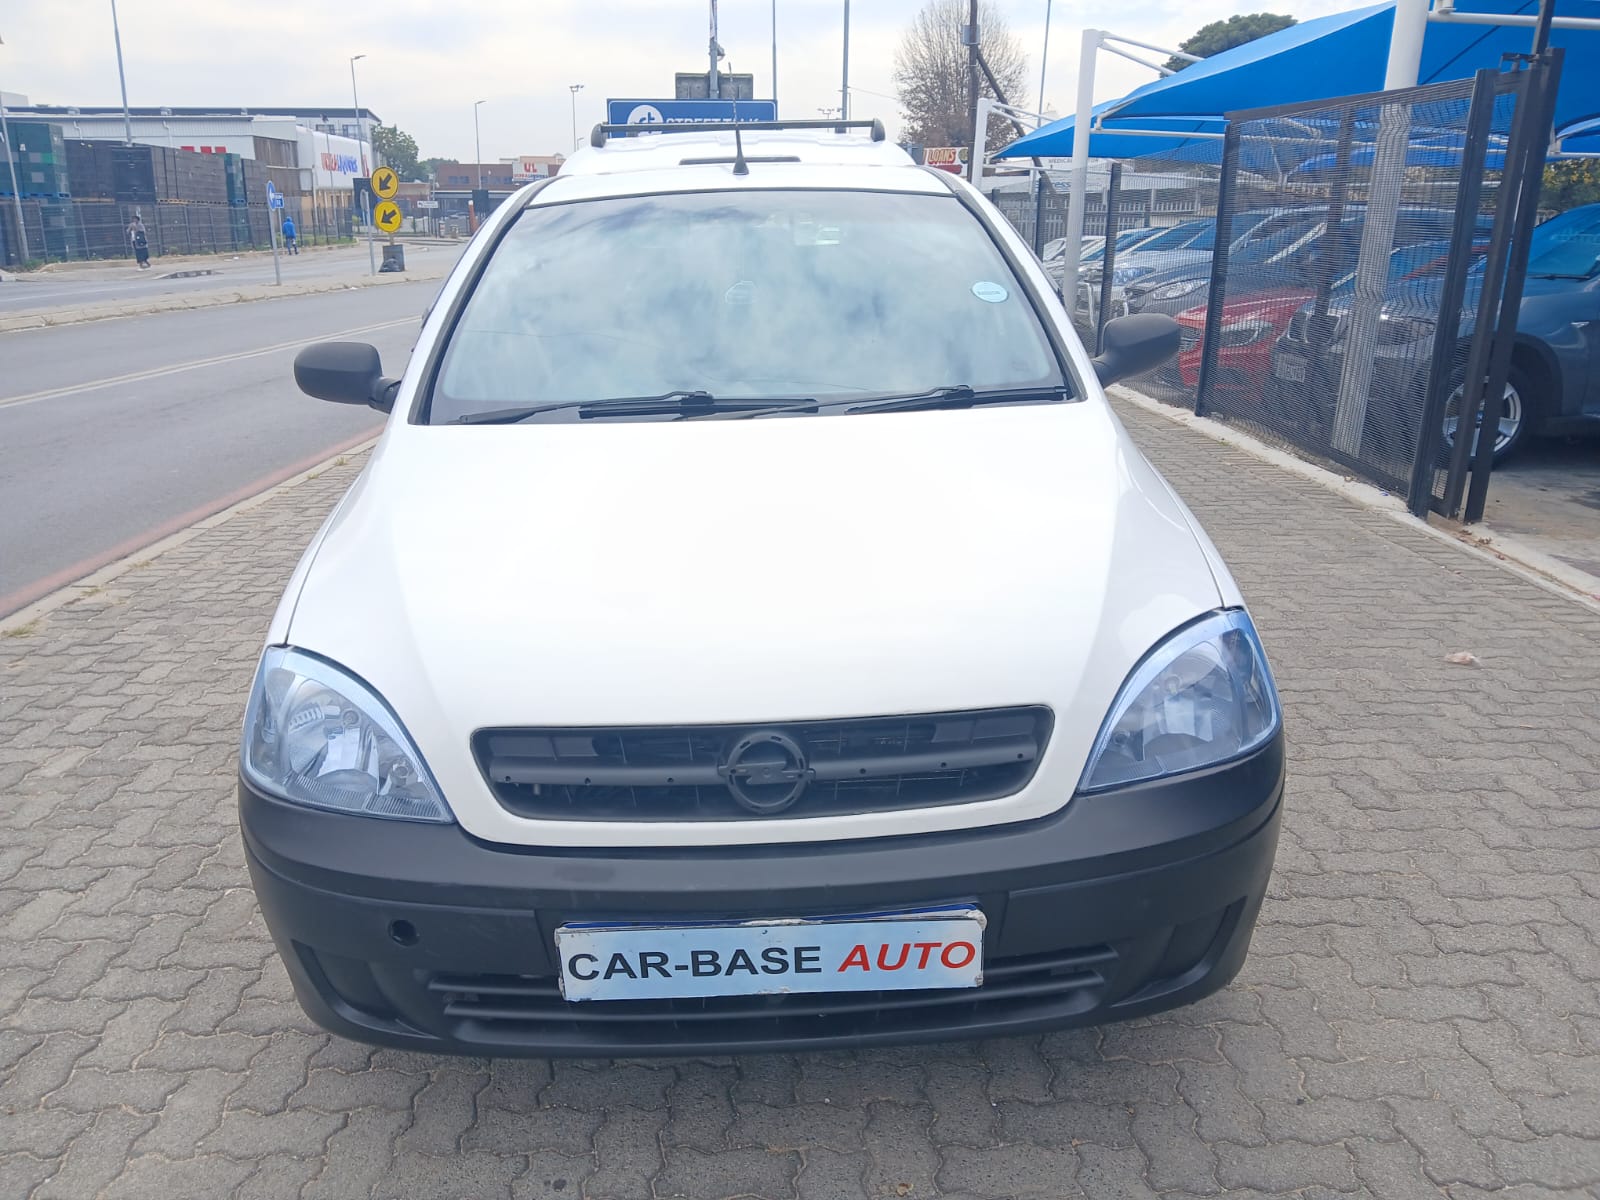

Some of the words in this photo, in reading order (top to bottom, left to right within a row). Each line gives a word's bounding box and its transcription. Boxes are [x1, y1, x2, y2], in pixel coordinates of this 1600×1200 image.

[928, 149, 956, 164] LOANS
[568, 946, 822, 980] CAR-BASE
[837, 941, 976, 973] AUTO
